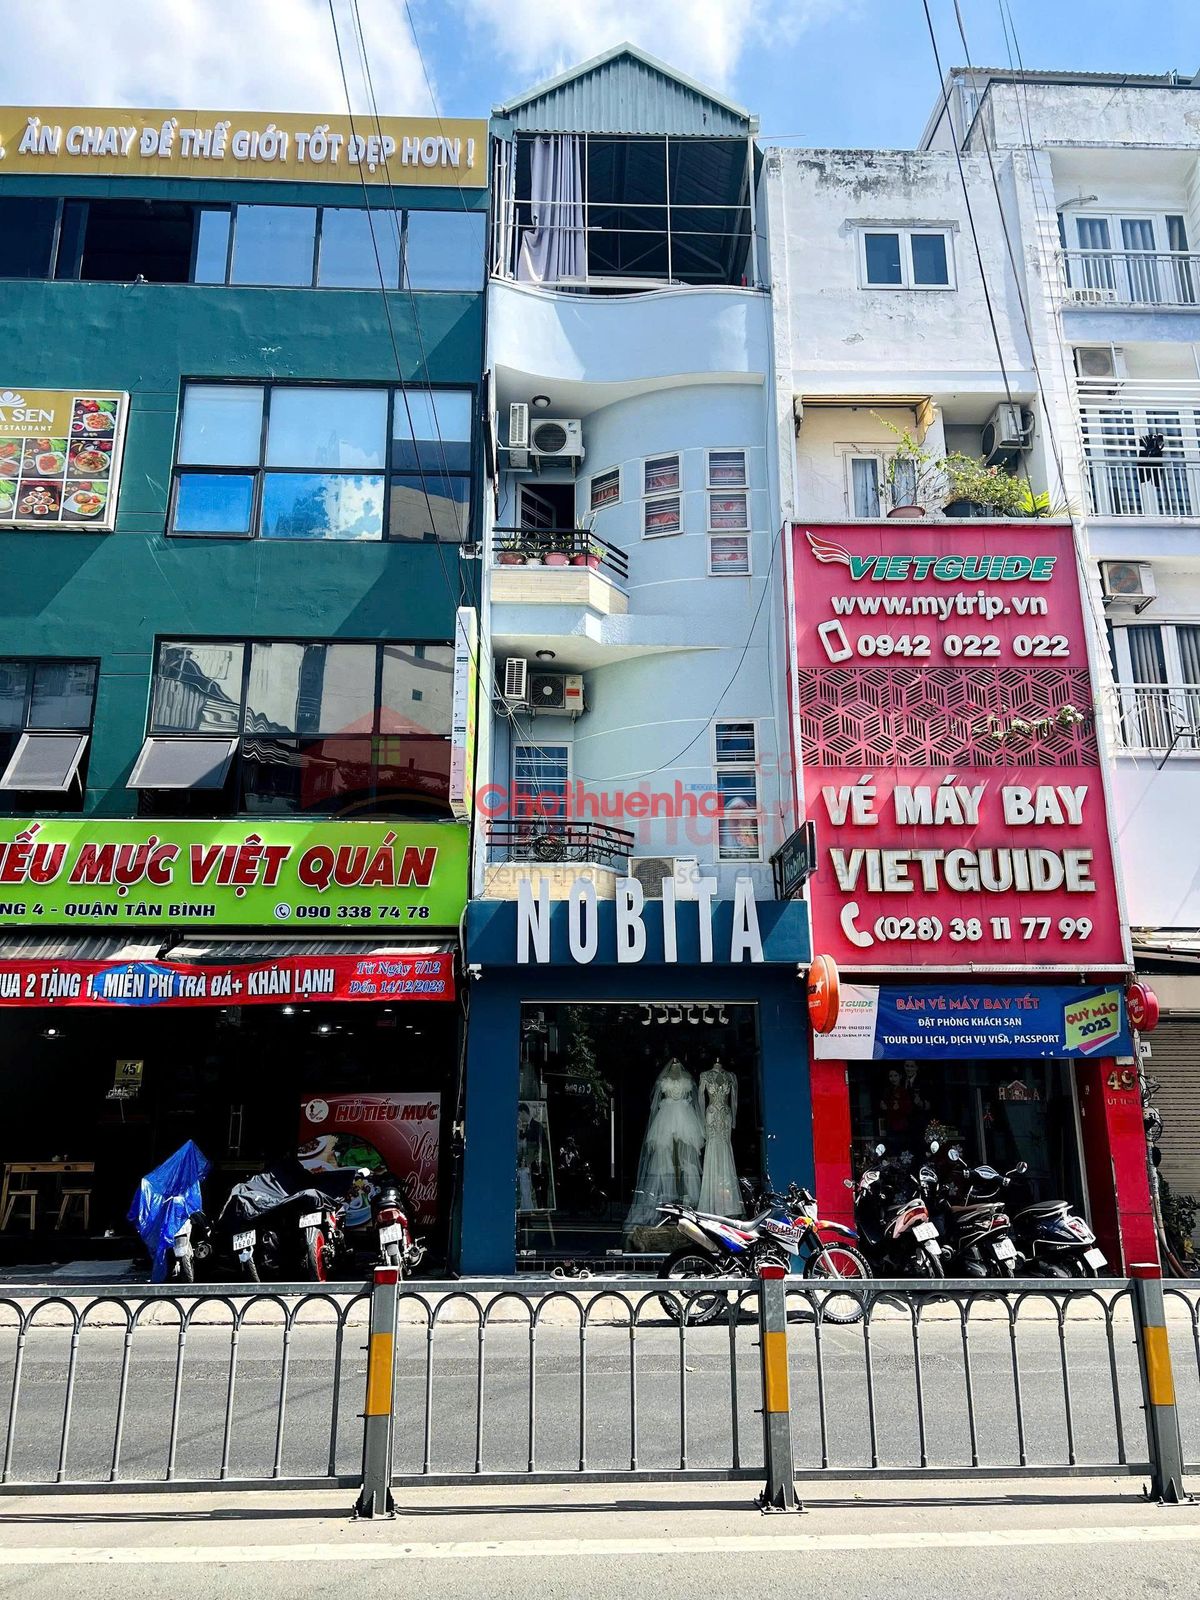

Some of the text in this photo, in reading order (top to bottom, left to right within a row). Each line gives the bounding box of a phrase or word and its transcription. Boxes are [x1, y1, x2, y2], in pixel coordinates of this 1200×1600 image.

[18, 116, 61, 155] ĂN
[65, 126, 137, 157] CHAY
[231, 123, 289, 162] GIỚI
[295, 123, 344, 164] TỐT
[347, 133, 396, 173] ĐẸP
[401, 136, 461, 168] HƠN
[12, 409, 55, 422] SEN
[849, 555, 1058, 580] VIETGUIDE
[831, 590, 1048, 621] www.mytrip.vn
[857, 634, 1071, 657] 0942 022 022
[822, 774, 1089, 826] VÉ MÁY BAY
[68, 835, 183, 898] MỰC
[189, 833, 292, 898] VIỆT
[298, 830, 438, 894] QUÁN
[829, 848, 1097, 893] VIETGUIDE
[32, 903, 44, 915] 4
[64, 902, 118, 918] QUẬN
[125, 902, 165, 916] TÂN
[168, 902, 216, 917] BÌNH
[296, 906, 430, 919] 090 338 74 78
[517, 876, 764, 965] NOBITA
[874, 916, 1093, 943] (028) 38 11 77 99
[376, 961, 412, 977] Ngày
[415, 960, 441, 974] 7/12
[25, 974, 36, 998] 2
[41, 968, 82, 1003] TẶNG
[103, 965, 145, 998] MIỄN
[148, 970, 176, 998] PHÍ
[178, 971, 206, 997] TRÀ
[247, 965, 291, 995] KHĂN
[294, 968, 335, 998] LẠNH
[380, 980, 445, 994] 14/12/2023
[949, 995, 980, 1010] MÁY
[983, 998, 1012, 1010] BAY
[1014, 993, 1040, 1010] TẾT
[1092, 1002, 1119, 1018] MÃO
[937, 1016, 970, 1027] PHÒNG
[971, 1016, 1001, 1026] KHÁCH
[1004, 1018, 1022, 1028] SẠN
[1078, 1016, 1112, 1037] 2023
[883, 1035, 908, 1044] TOUR
[911, 1036, 923, 1044] DU
[925, 1036, 948, 1045] LỊCH,
[950, 1035, 972, 1045] DỊCH
[975, 1035, 987, 1045] VỤ
[1014, 1034, 1060, 1043] PASSPORT
[1107, 1070, 1137, 1092] 49
